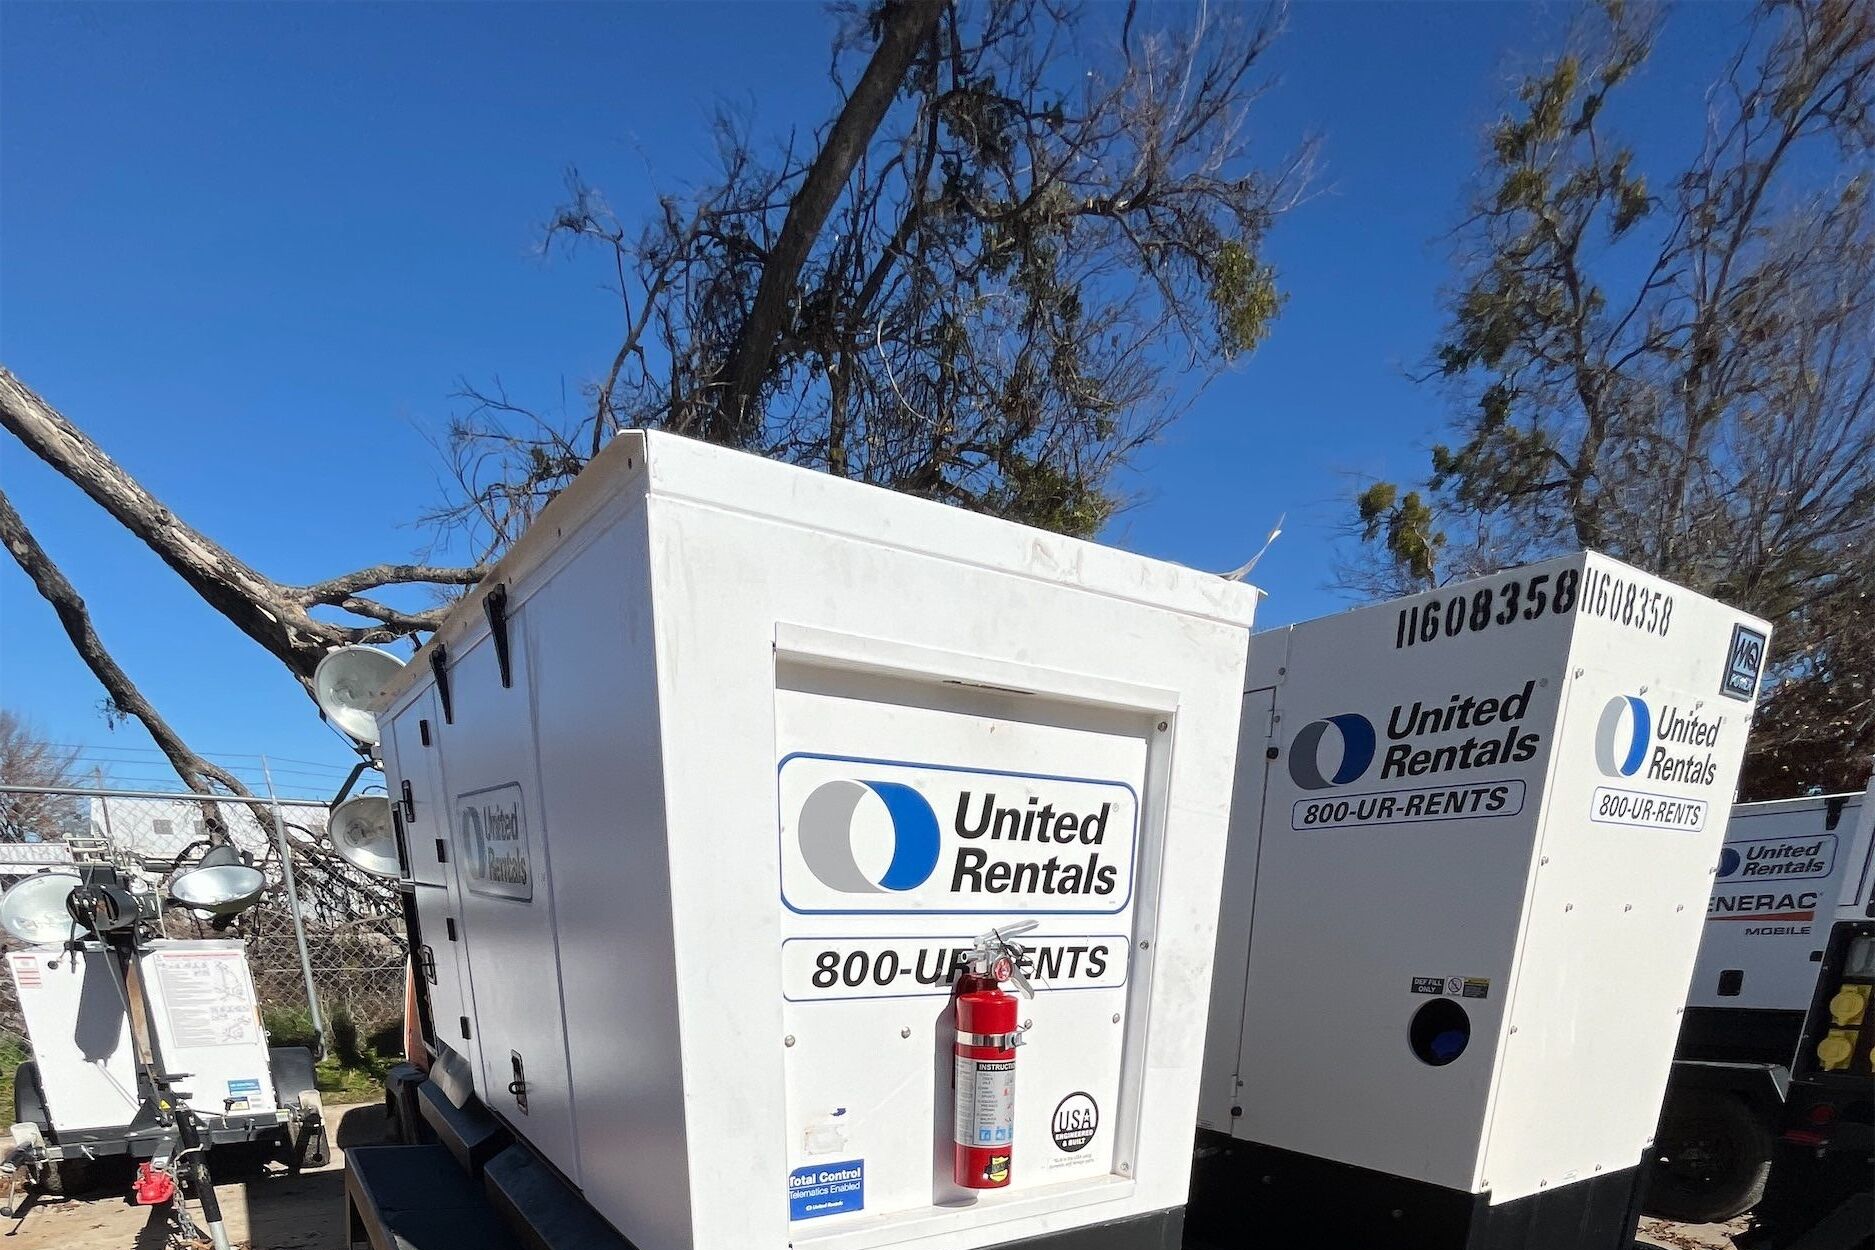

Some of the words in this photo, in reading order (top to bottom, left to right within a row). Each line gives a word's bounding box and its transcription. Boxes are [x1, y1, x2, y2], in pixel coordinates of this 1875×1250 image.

[1396, 569, 1578, 649] 11608358
[1581, 567, 1673, 637] 11608358
[1387, 680, 1535, 740] United
[1657, 705, 1722, 747] United
[1380, 725, 1540, 779] Rentals
[1647, 746, 1717, 785] Rentals
[483, 801, 519, 840] United
[954, 791, 1111, 844] United
[1304, 787, 1509, 825] 800-UR-RENTS
[1599, 794, 1701, 826] 800-UR-RENTS
[487, 847, 527, 885] Rentals
[1742, 858, 1825, 876] Rentals
[1746, 841, 1823, 861] United
[950, 847, 1117, 895] Rentals
[1745, 926, 1811, 936] MOBILE
[811, 945, 1109, 987] 800-URENTS
[1060, 1109, 1091, 1130] USA
[789, 1173, 816, 1187] Total
[819, 1167, 861, 1182] Control
[789, 1187, 829, 1199] Telematics
[830, 1181, 860, 1194] Enabled
